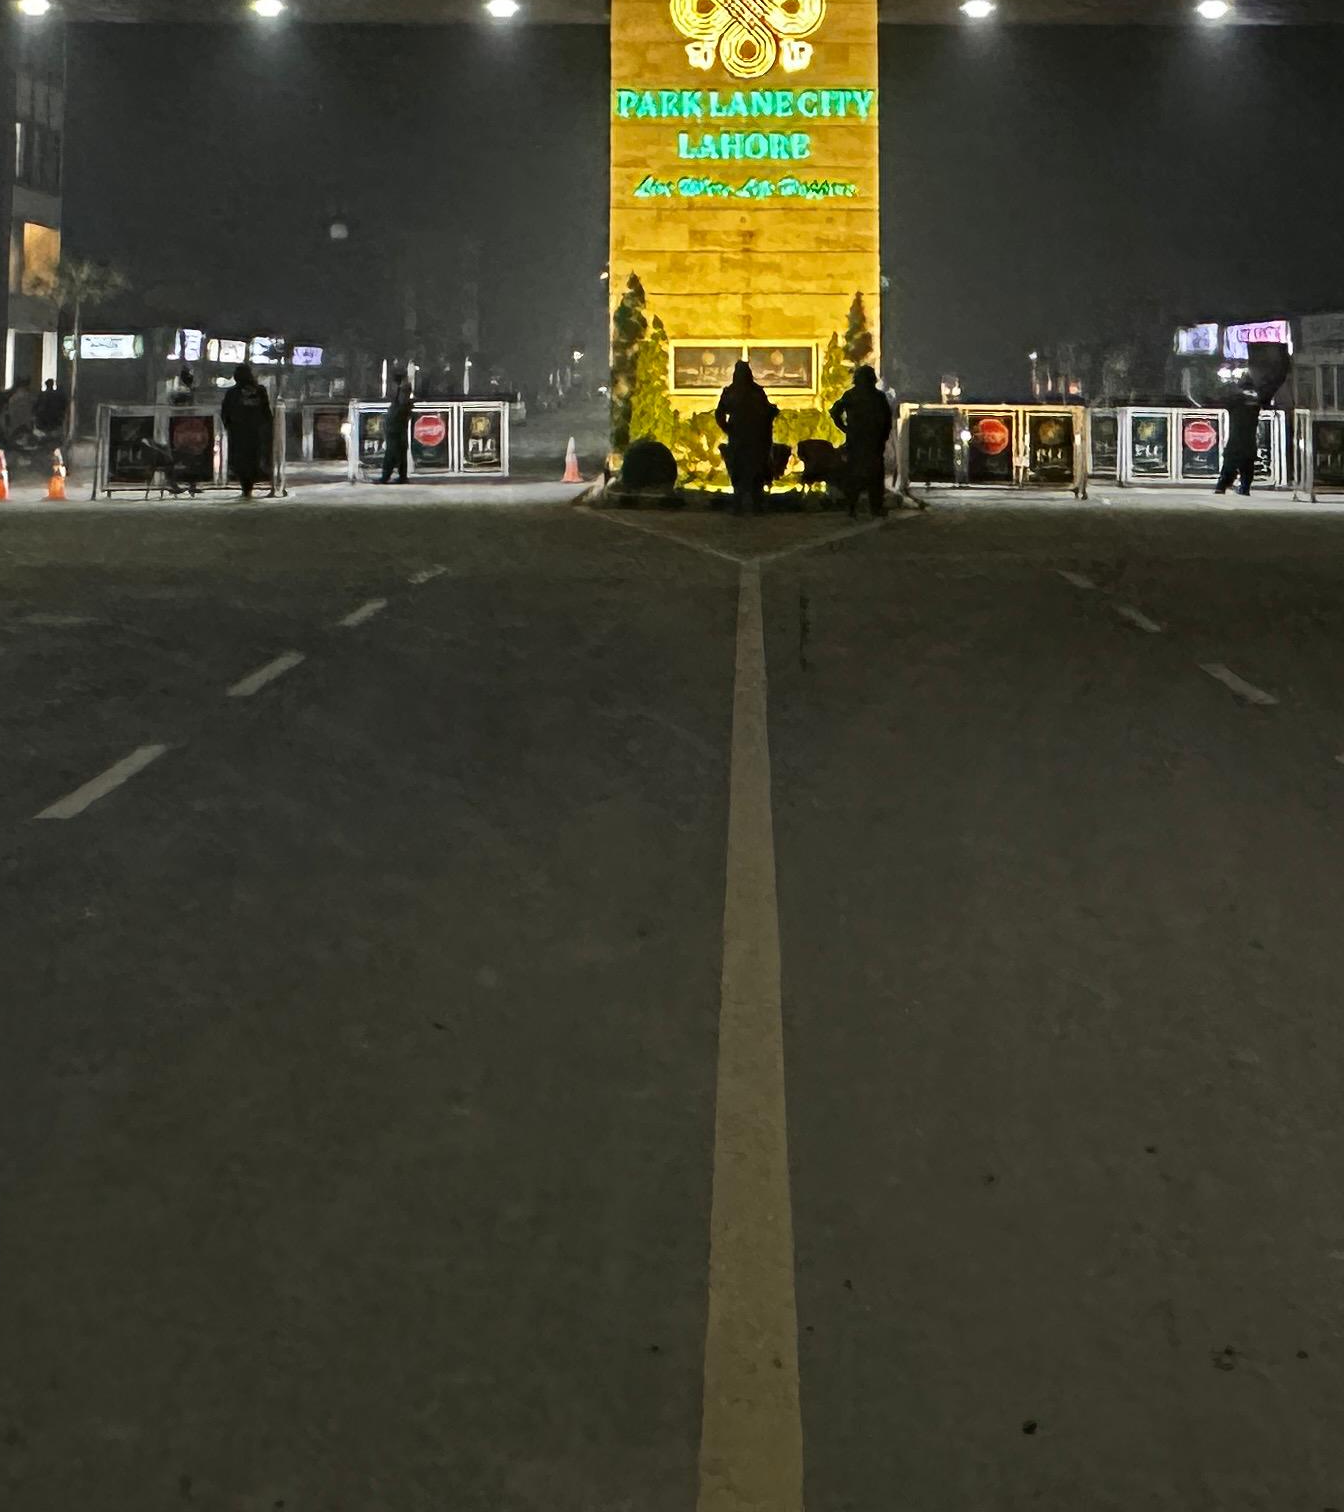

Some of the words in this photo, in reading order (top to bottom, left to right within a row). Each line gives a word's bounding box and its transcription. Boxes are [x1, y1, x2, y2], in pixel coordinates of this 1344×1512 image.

[617, 88, 703, 118] PARK
[709, 89, 794, 118] LANE
[797, 89, 874, 119] CITY
[678, 130, 812, 160] LAHORE
